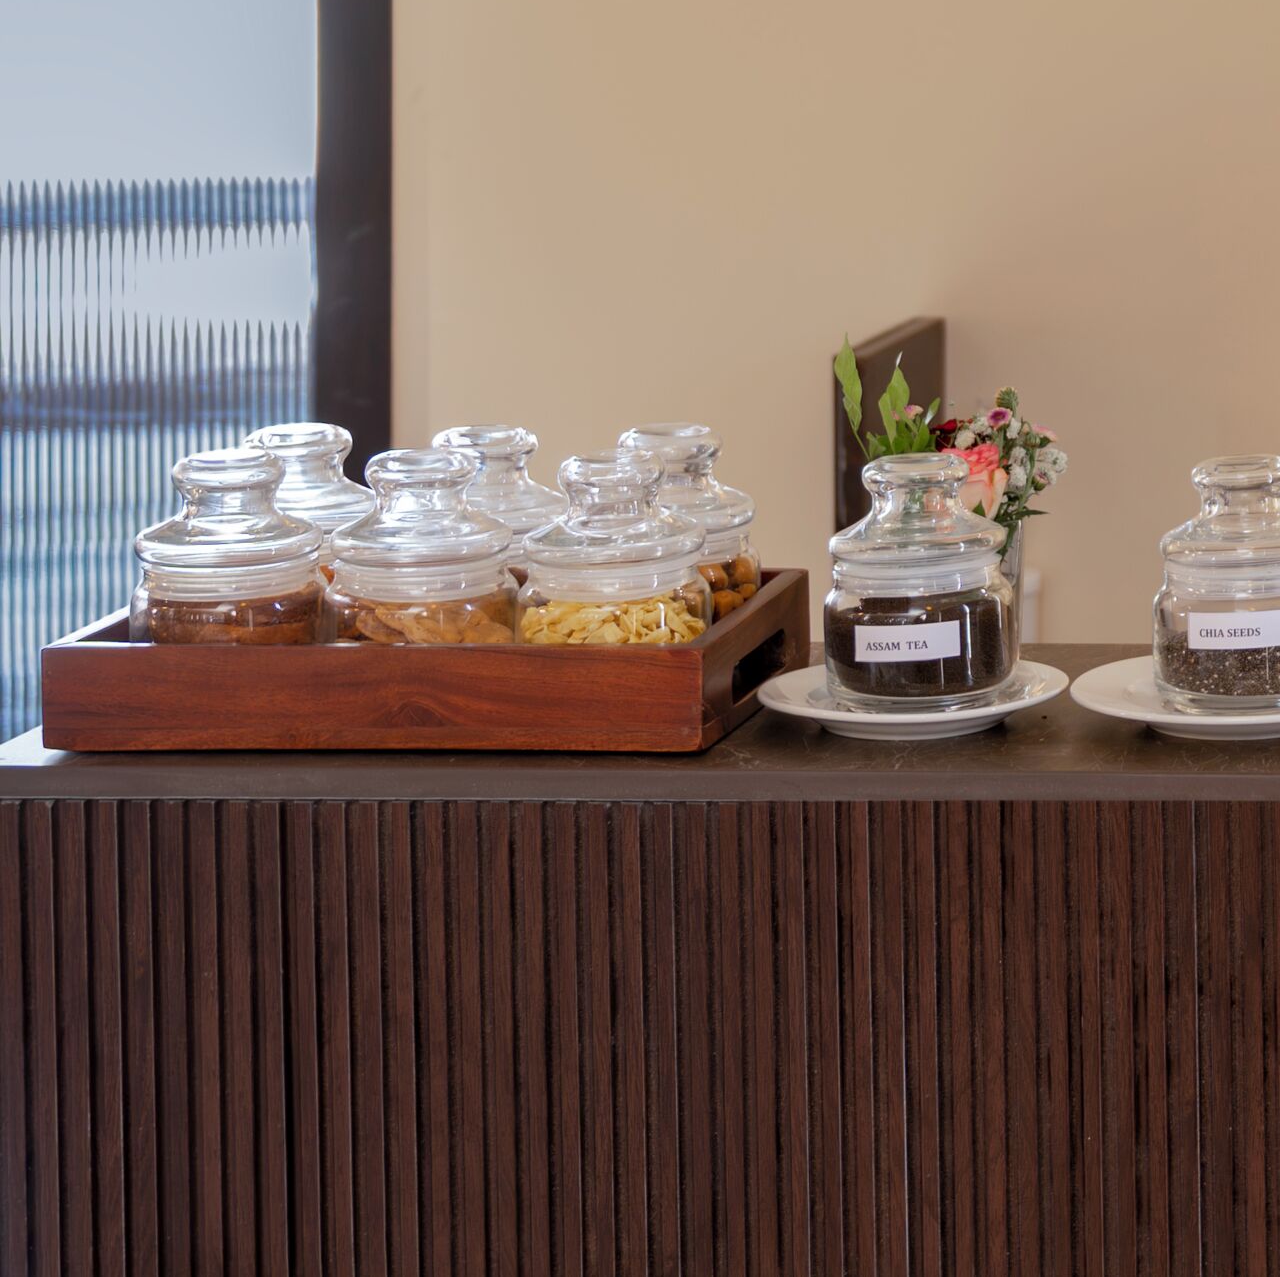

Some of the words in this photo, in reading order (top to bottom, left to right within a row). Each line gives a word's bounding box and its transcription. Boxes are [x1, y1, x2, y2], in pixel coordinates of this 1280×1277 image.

[1199, 628, 1225, 638] CHIA
[1226, 627, 1262, 638] SEEDS
[865, 641, 901, 652] ASSAM
[905, 639, 929, 650] TEA
